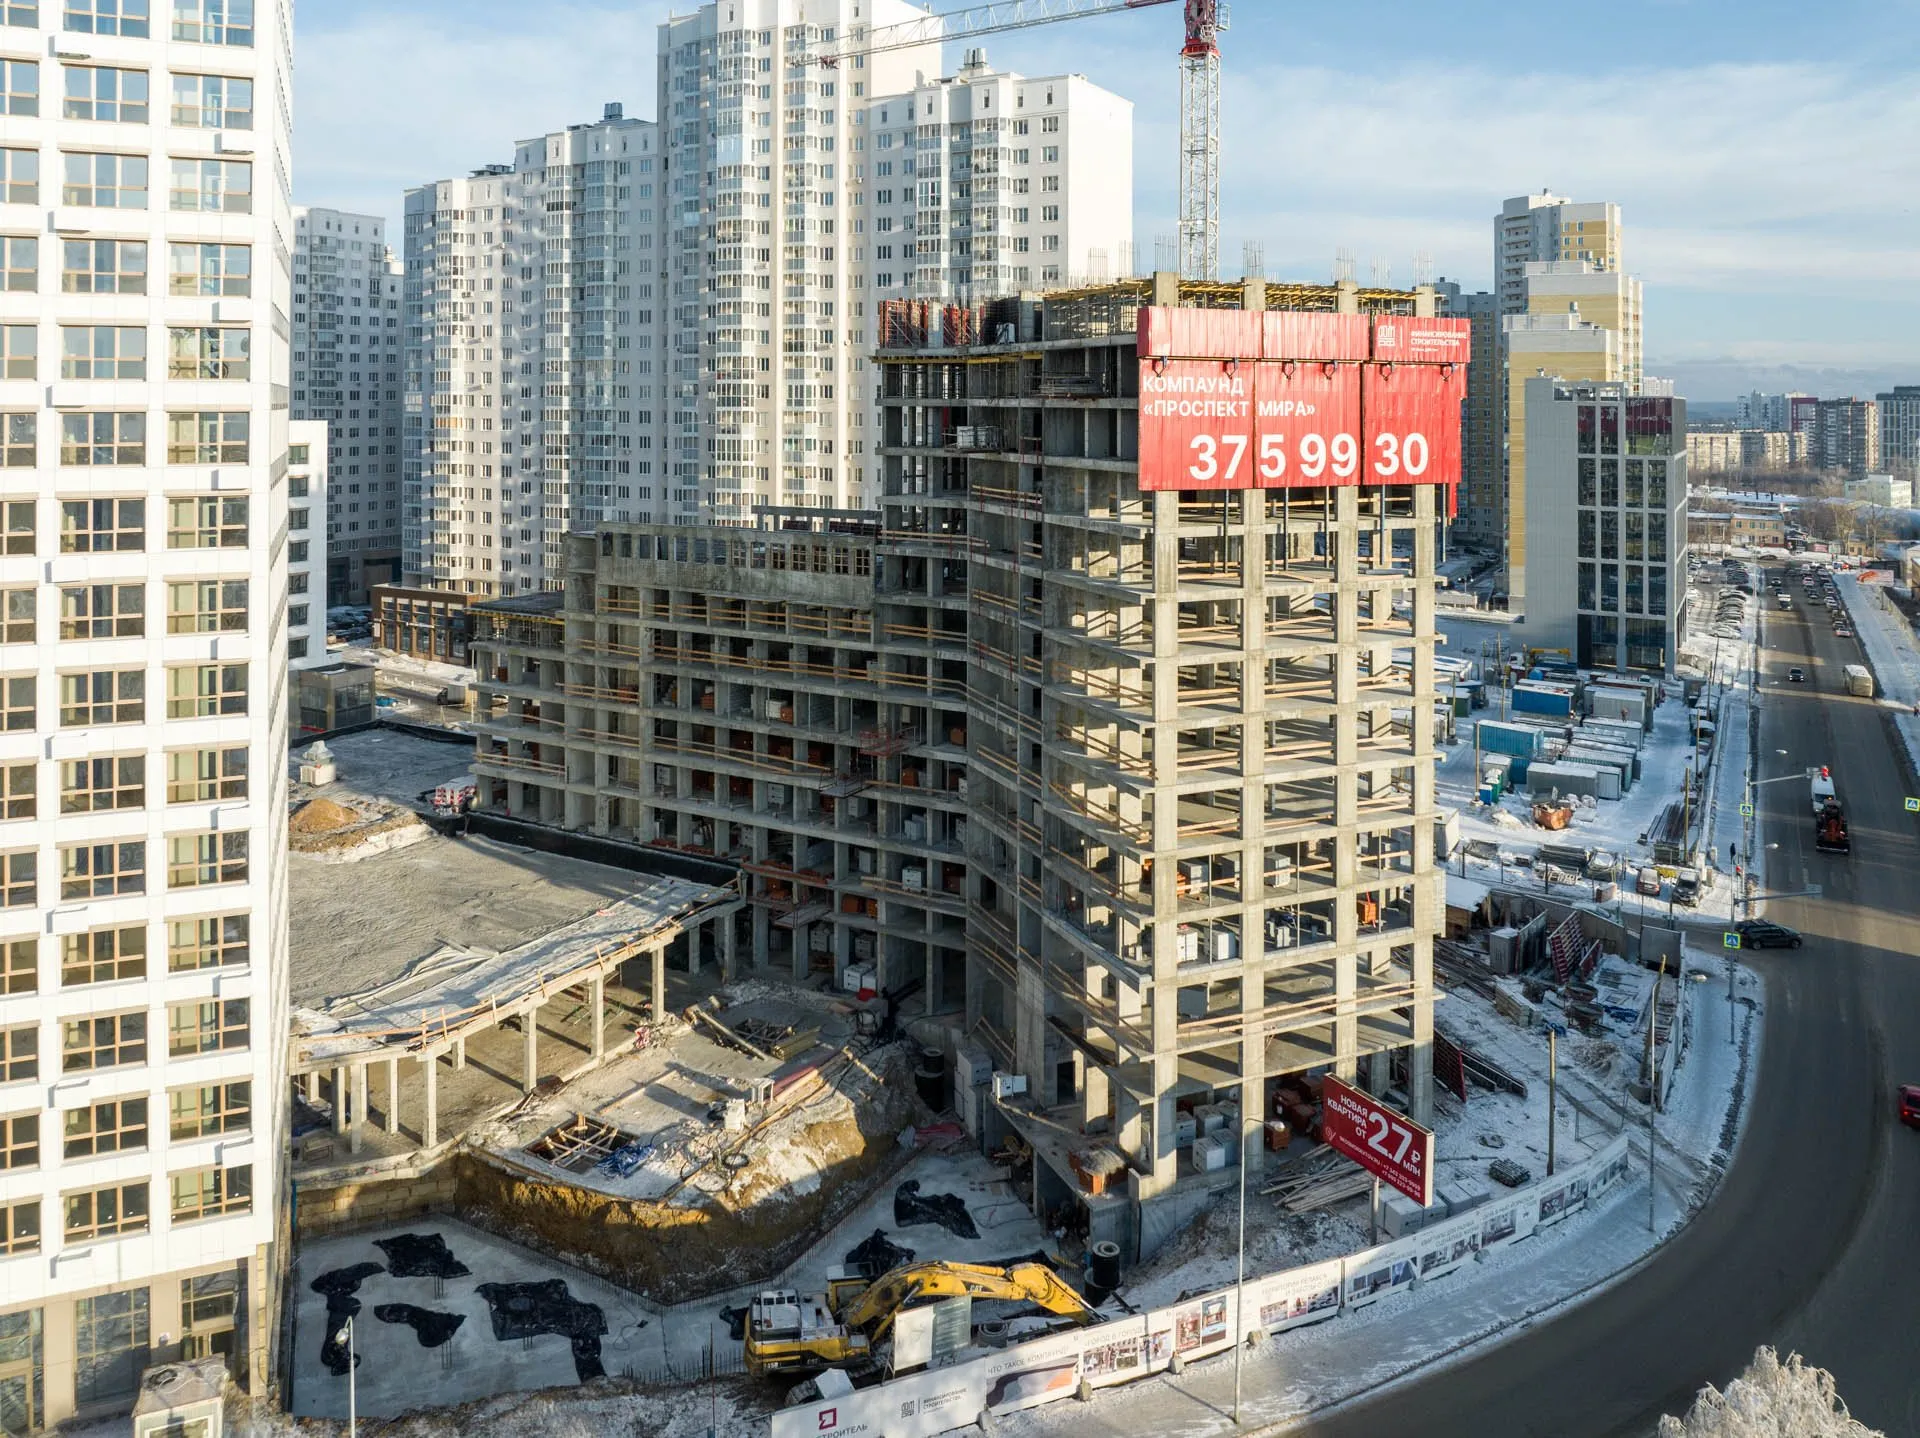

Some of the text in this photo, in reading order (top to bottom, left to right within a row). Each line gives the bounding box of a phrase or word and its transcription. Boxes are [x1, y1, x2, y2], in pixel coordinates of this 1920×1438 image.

[1143, 376, 1244, 396] КОМПАУНД
[1144, 399, 1316, 417] «ПРОСПЕКТ МИРА»
[1300, 433, 1358, 478] 99
[1374, 432, 1429, 476] 30
[1328, 1098, 1367, 1129] КВАРТИРА
[1340, 1094, 1368, 1116] НОВАЯ
[1356, 1126, 1421, 1176] ОТ МЛН
[988, 1364, 1002, 1374] ЧТО
[1004, 1359, 1025, 1371] ТАКОЕ
